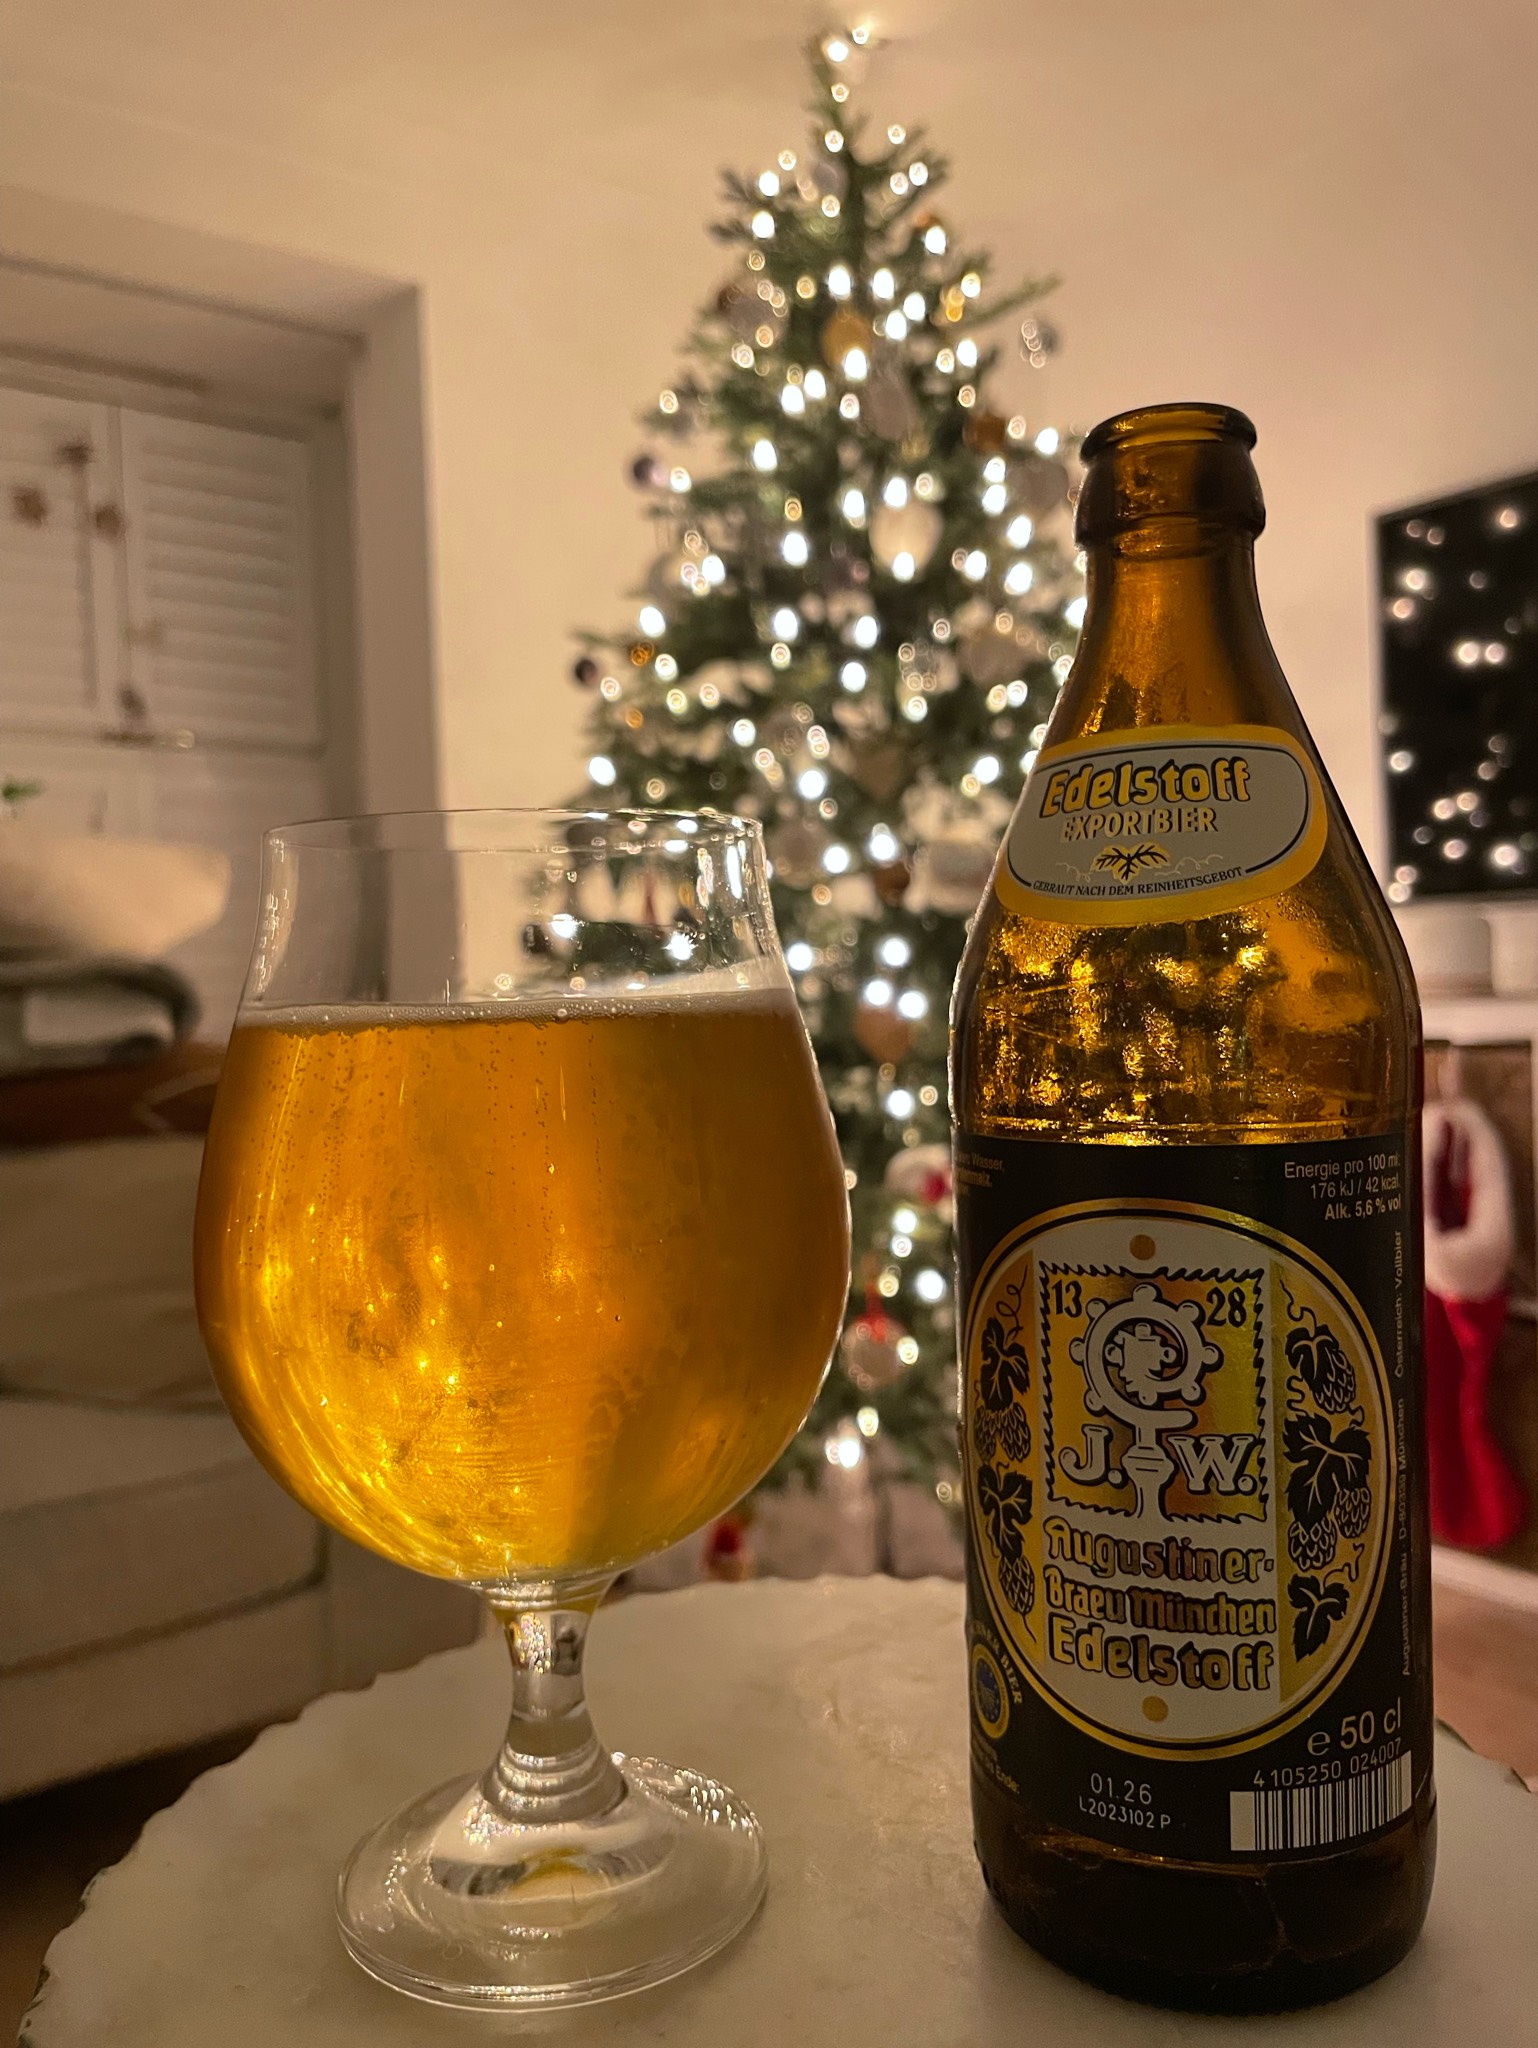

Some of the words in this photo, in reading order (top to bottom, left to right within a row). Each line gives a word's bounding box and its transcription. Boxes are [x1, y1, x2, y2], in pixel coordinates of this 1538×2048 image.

[1039, 756, 1250, 818] Edelstoff
[1061, 806, 1218, 843] EXPORTBIER
[1033, 880, 1075, 895] GEBRAUT
[1076, 885, 1106, 896] NACH
[1108, 885, 1134, 896] DEM
[1137, 866, 1243, 894] REINHEITSGEBOT
[1284, 1160, 1340, 1181] Energie
[1344, 1159, 1364, 1179] pro
[1367, 1153, 1386, 1171] 100
[1310, 1181, 1336, 1199] 176
[1340, 1178, 1354, 1197] kJ
[1365, 1176, 1379, 1193] 42
[1325, 1202, 1352, 1220] Alk.
[1355, 1199, 1373, 1219] 5,6
[1375, 1198, 1386, 1213] %
[1387, 1193, 1401, 1211] vol
[1394, 1230, 1403, 1290] Vollbier
[1051, 1280, 1083, 1317] 13
[1206, 1286, 1248, 1327] 28
[1058, 1423, 1126, 1488] J.
[1166, 1433, 1259, 1495] W.
[1043, 1515, 1275, 1584] Augustiner-
[1043, 1564, 1127, 1624] Braeu
[1126, 1585, 1277, 1636] München
[1048, 1612, 1274, 1691] Edelstoff
[1340, 1710, 1375, 1749] 50
[1383, 1696, 1401, 1734] cl
[1270, 1760, 1342, 1787] 105250
[1350, 1736, 1402, 1774] 024007
[1079, 1795, 1155, 1828] L2023102
[1160, 1814, 1171, 1829] P
[1090, 1772, 1152, 1804] 01.26
